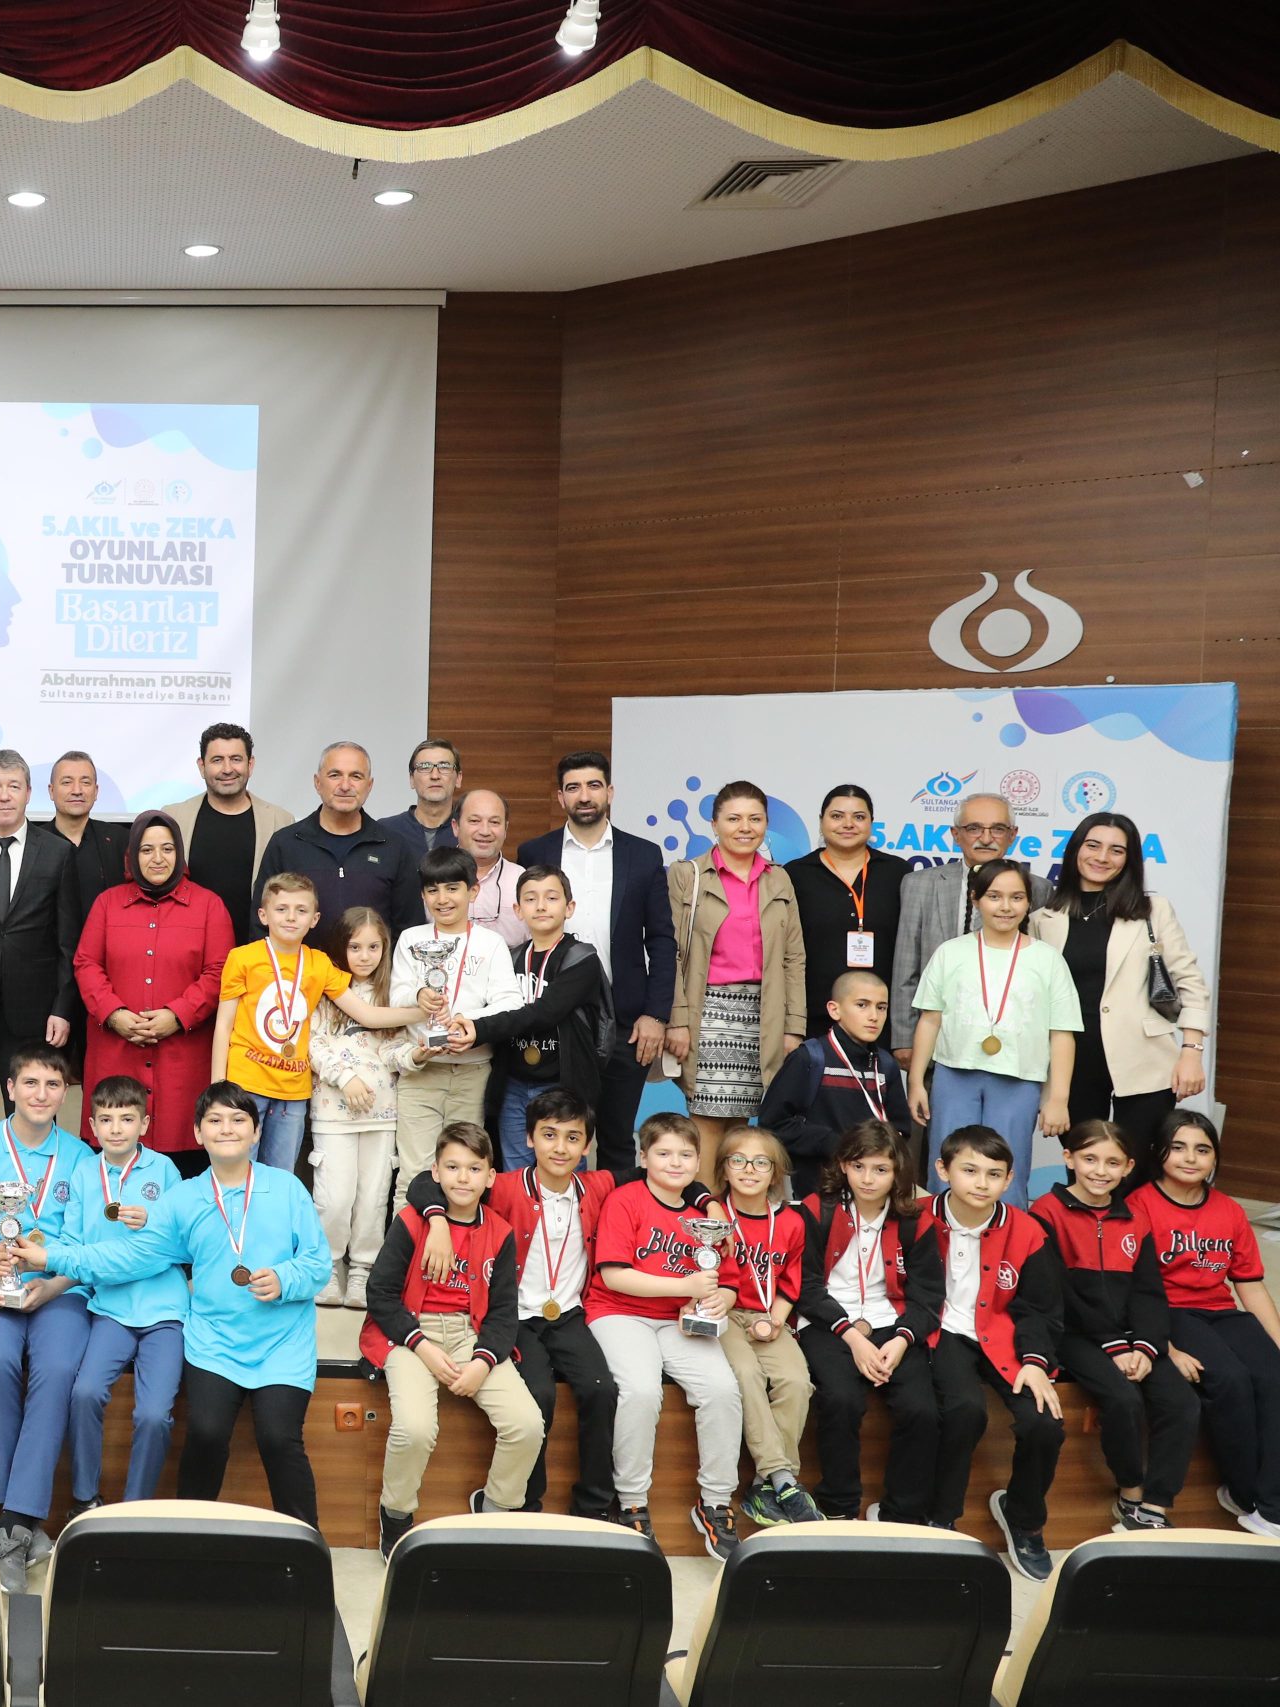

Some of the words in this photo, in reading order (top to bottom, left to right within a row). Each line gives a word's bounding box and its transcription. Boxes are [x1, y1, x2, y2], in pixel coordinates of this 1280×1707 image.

[41, 515, 125, 538] 5.AKIL
[130, 521, 161, 538] ve
[166, 517, 236, 539] ZEKA
[69, 539, 207, 562] OYUNLARI
[61, 563, 213, 586] TURNUVASI
[61, 592, 214, 624] Başarılar
[85, 624, 189, 654] Dileriz
[40, 673, 156, 688] Abdurrahman
[160, 675, 232, 689] DURSUN
[40, 689, 113, 701] Sultangazi
[116, 690, 175, 702] Belediye
[177, 691, 231, 703] Başkanı
